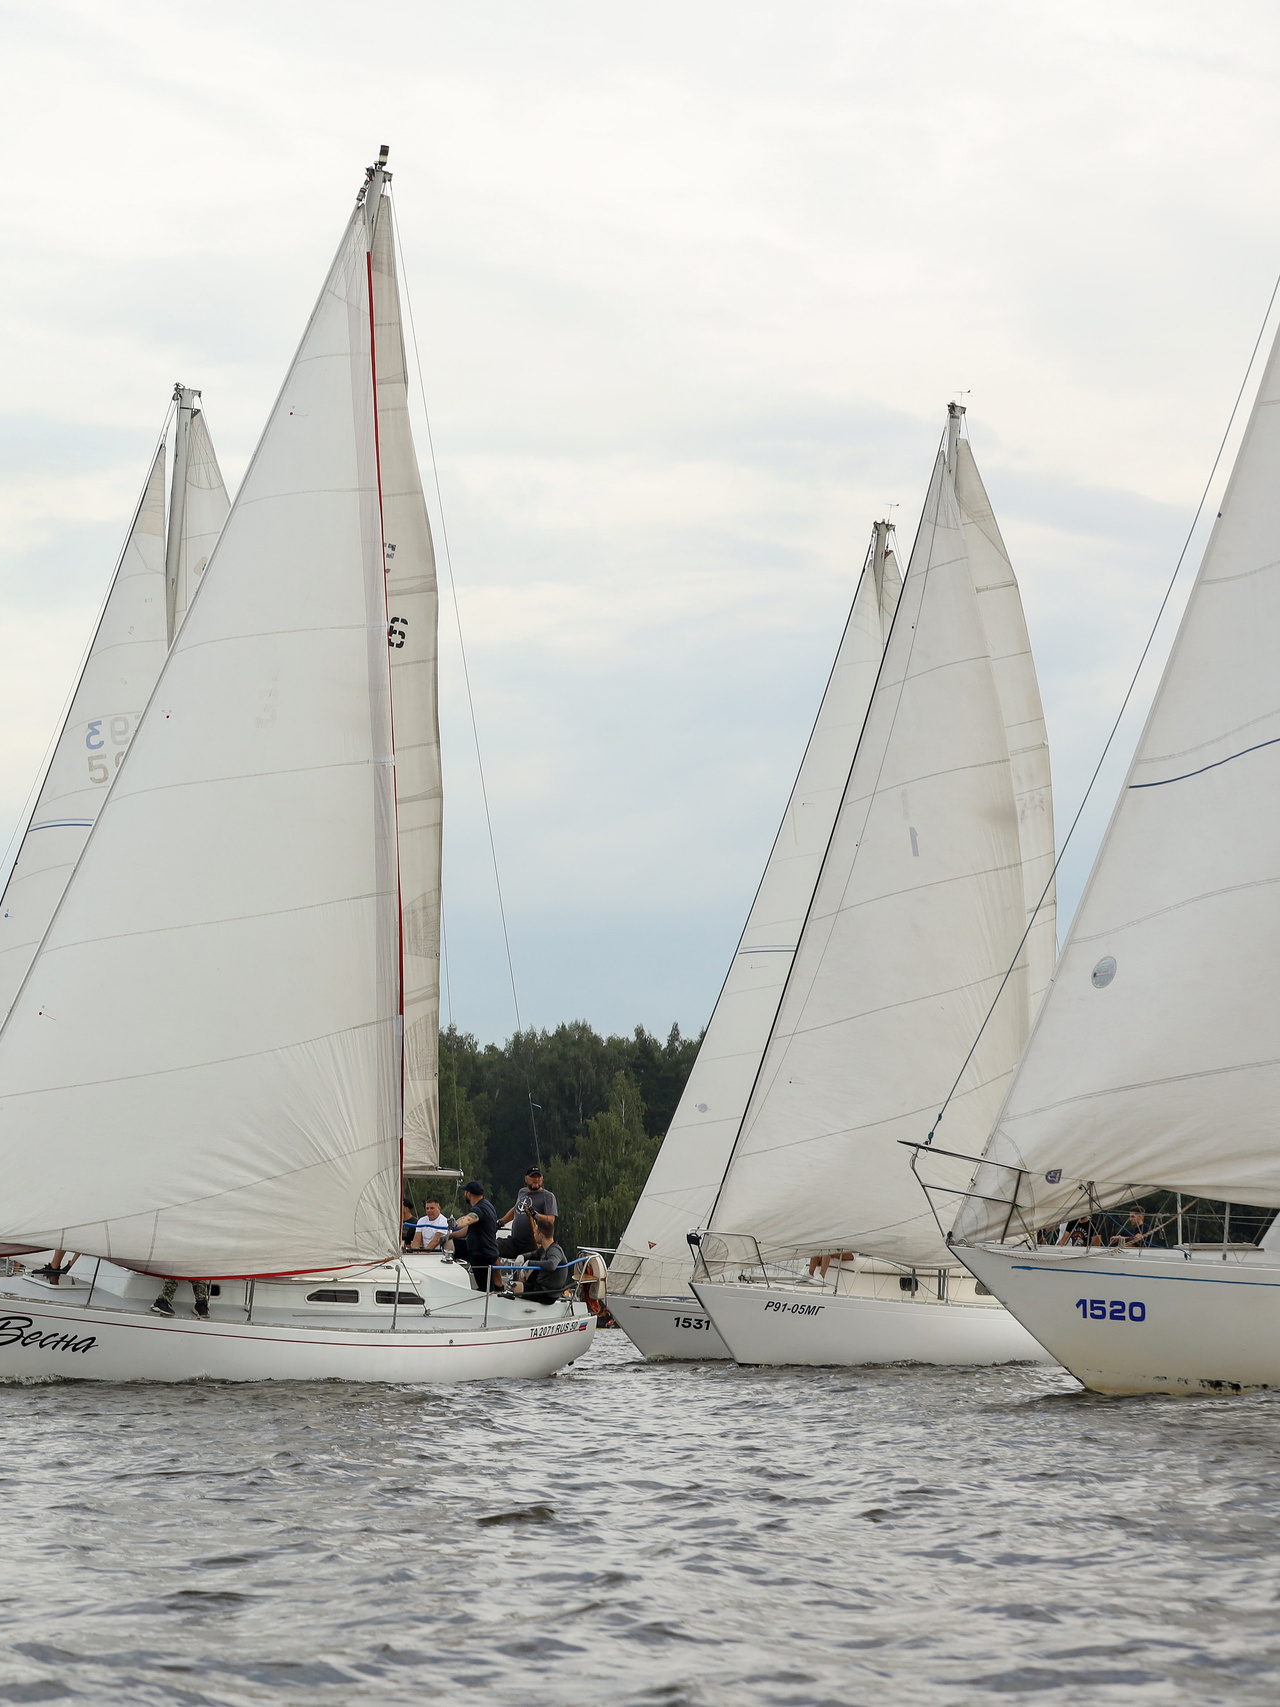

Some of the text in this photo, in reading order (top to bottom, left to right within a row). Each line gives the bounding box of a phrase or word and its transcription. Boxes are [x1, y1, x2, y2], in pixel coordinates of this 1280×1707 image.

[1075, 1299, 1146, 1322] 1520
[555, 1322, 570, 1333] RUS
[673, 1316, 711, 1331] 1531
